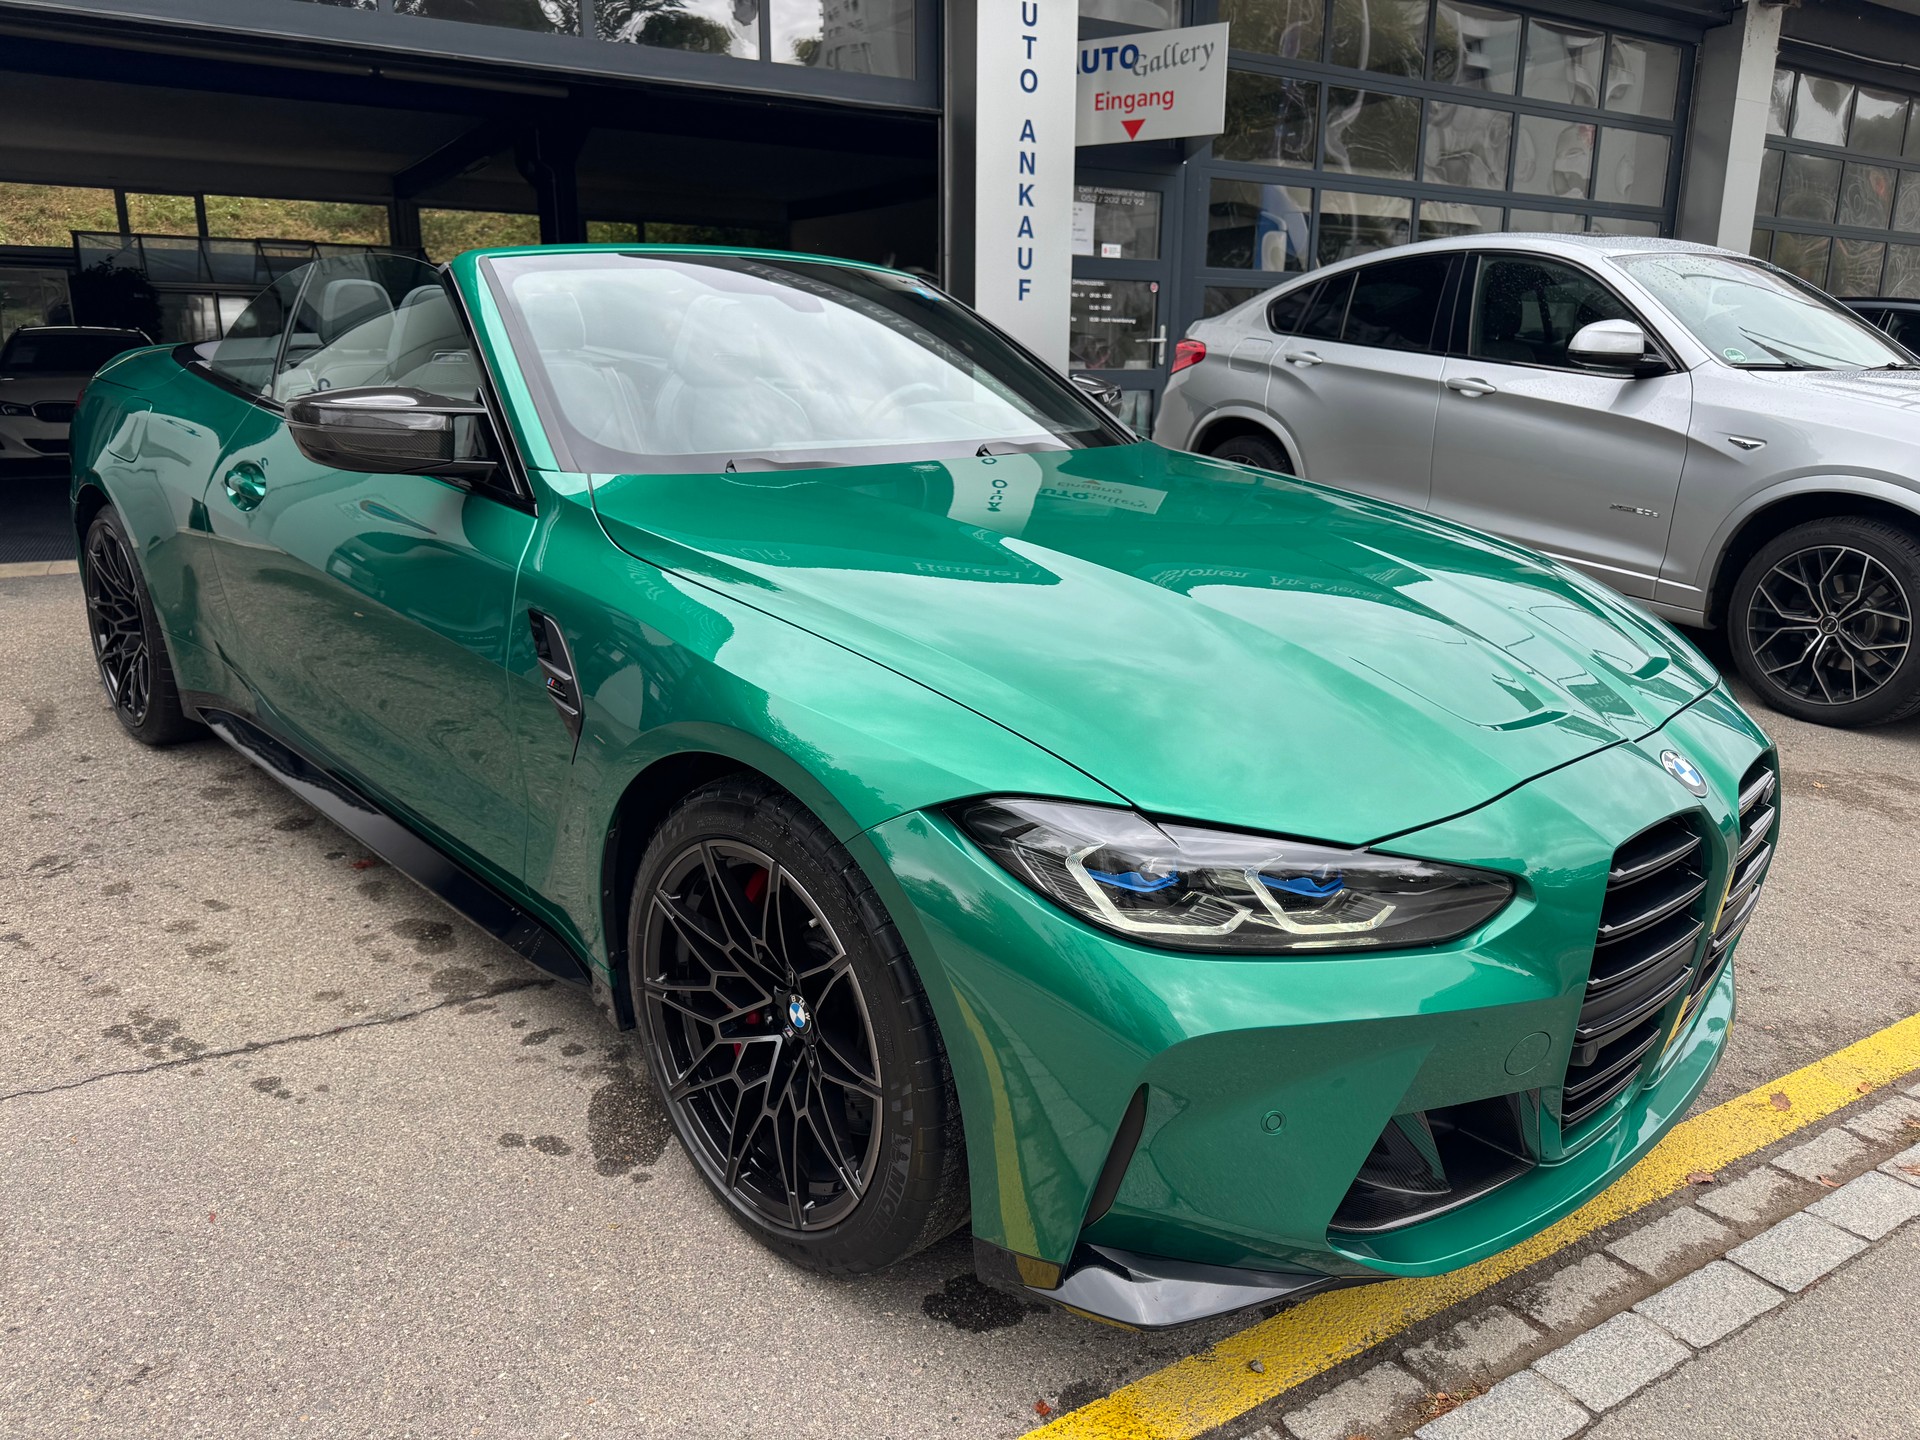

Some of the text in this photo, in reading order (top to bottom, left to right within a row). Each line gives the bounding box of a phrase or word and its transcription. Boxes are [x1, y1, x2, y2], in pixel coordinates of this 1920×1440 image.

[1077, 41, 1215, 77] UTO Gallery
[1095, 90, 1175, 114] Eingang
[1017, 119, 1036, 301] ANKAUF
[790, 995, 811, 1020] BMW
